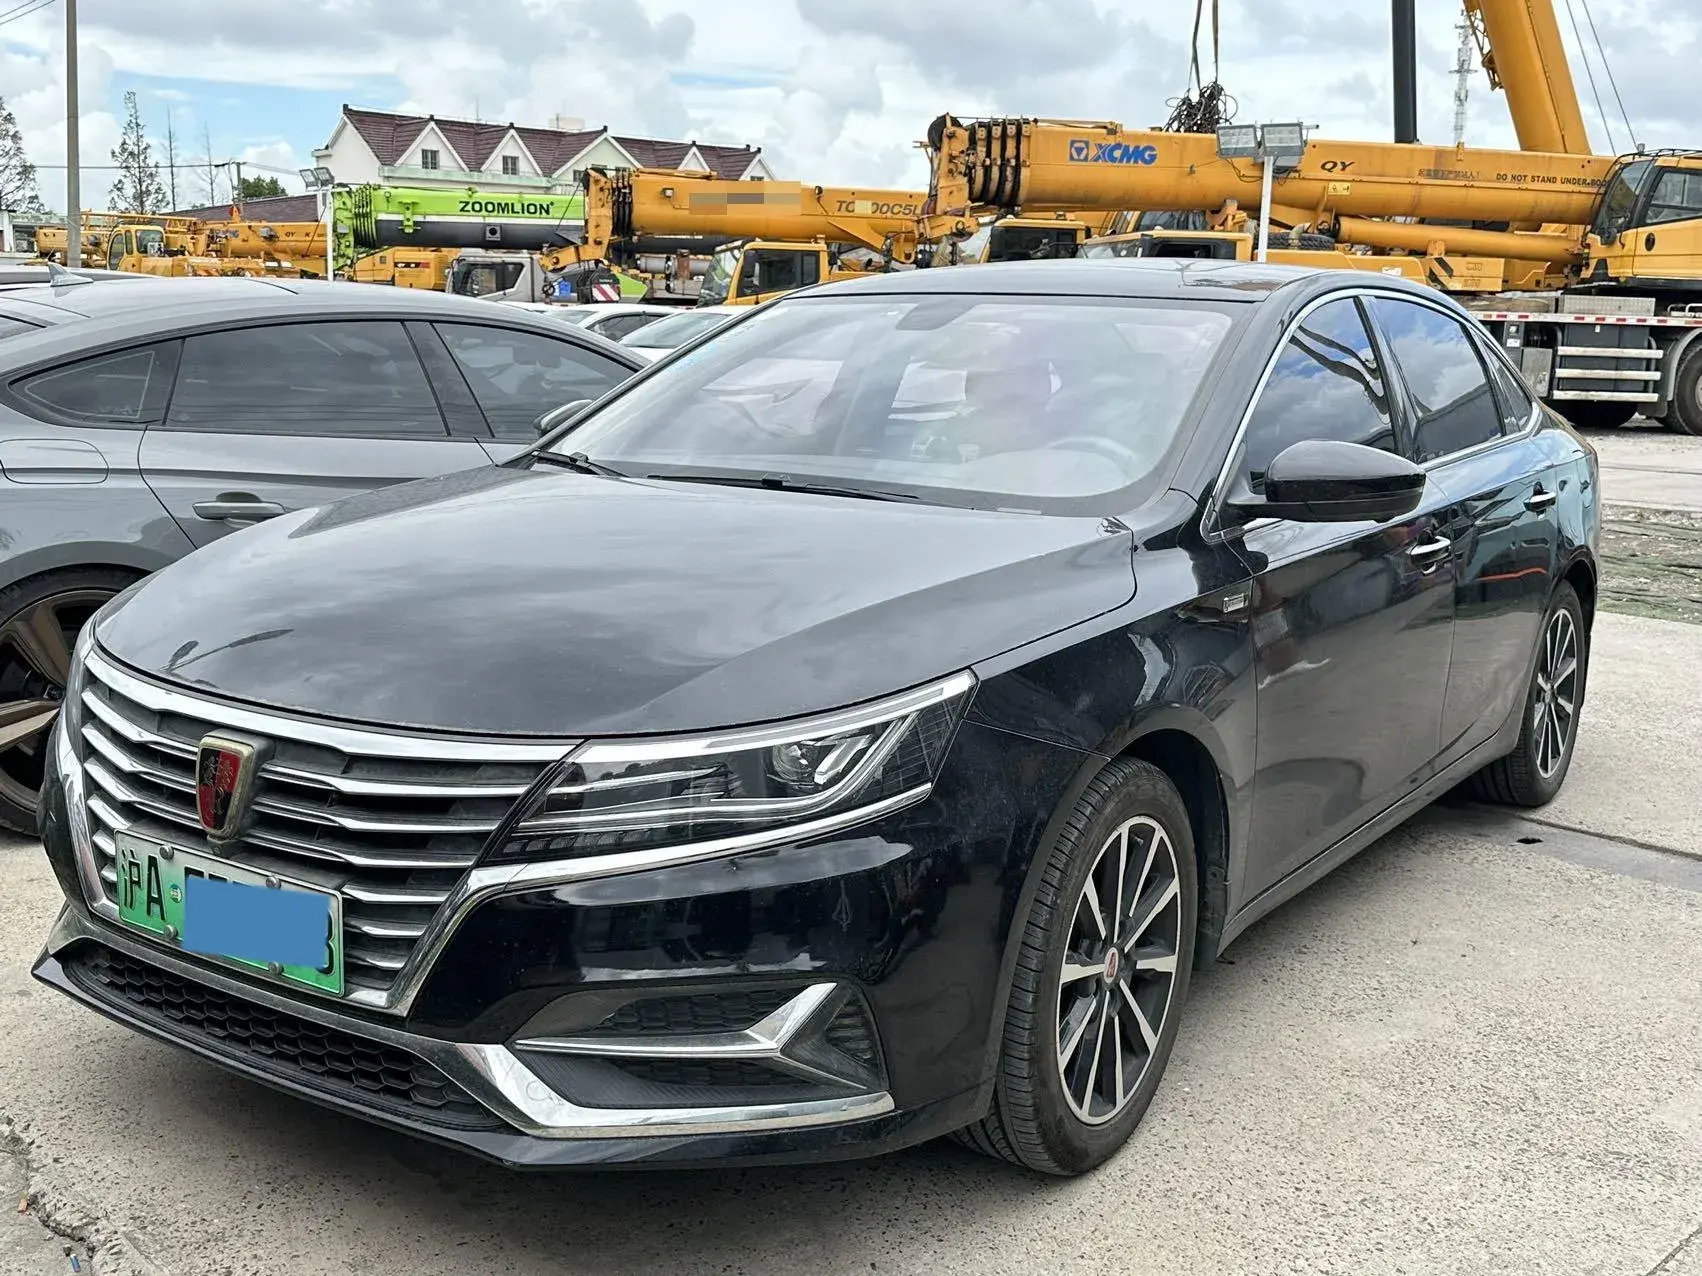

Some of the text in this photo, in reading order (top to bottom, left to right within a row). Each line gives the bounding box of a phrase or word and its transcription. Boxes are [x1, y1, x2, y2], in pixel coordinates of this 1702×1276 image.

[1089, 143, 1158, 165] XCMG
[1320, 160, 1355, 173] QY
[1496, 173, 1508, 181] DO
[1511, 174, 1528, 182] NOT
[1530, 175, 1557, 184] STAND
[459, 201, 550, 215] ZOOMLION
